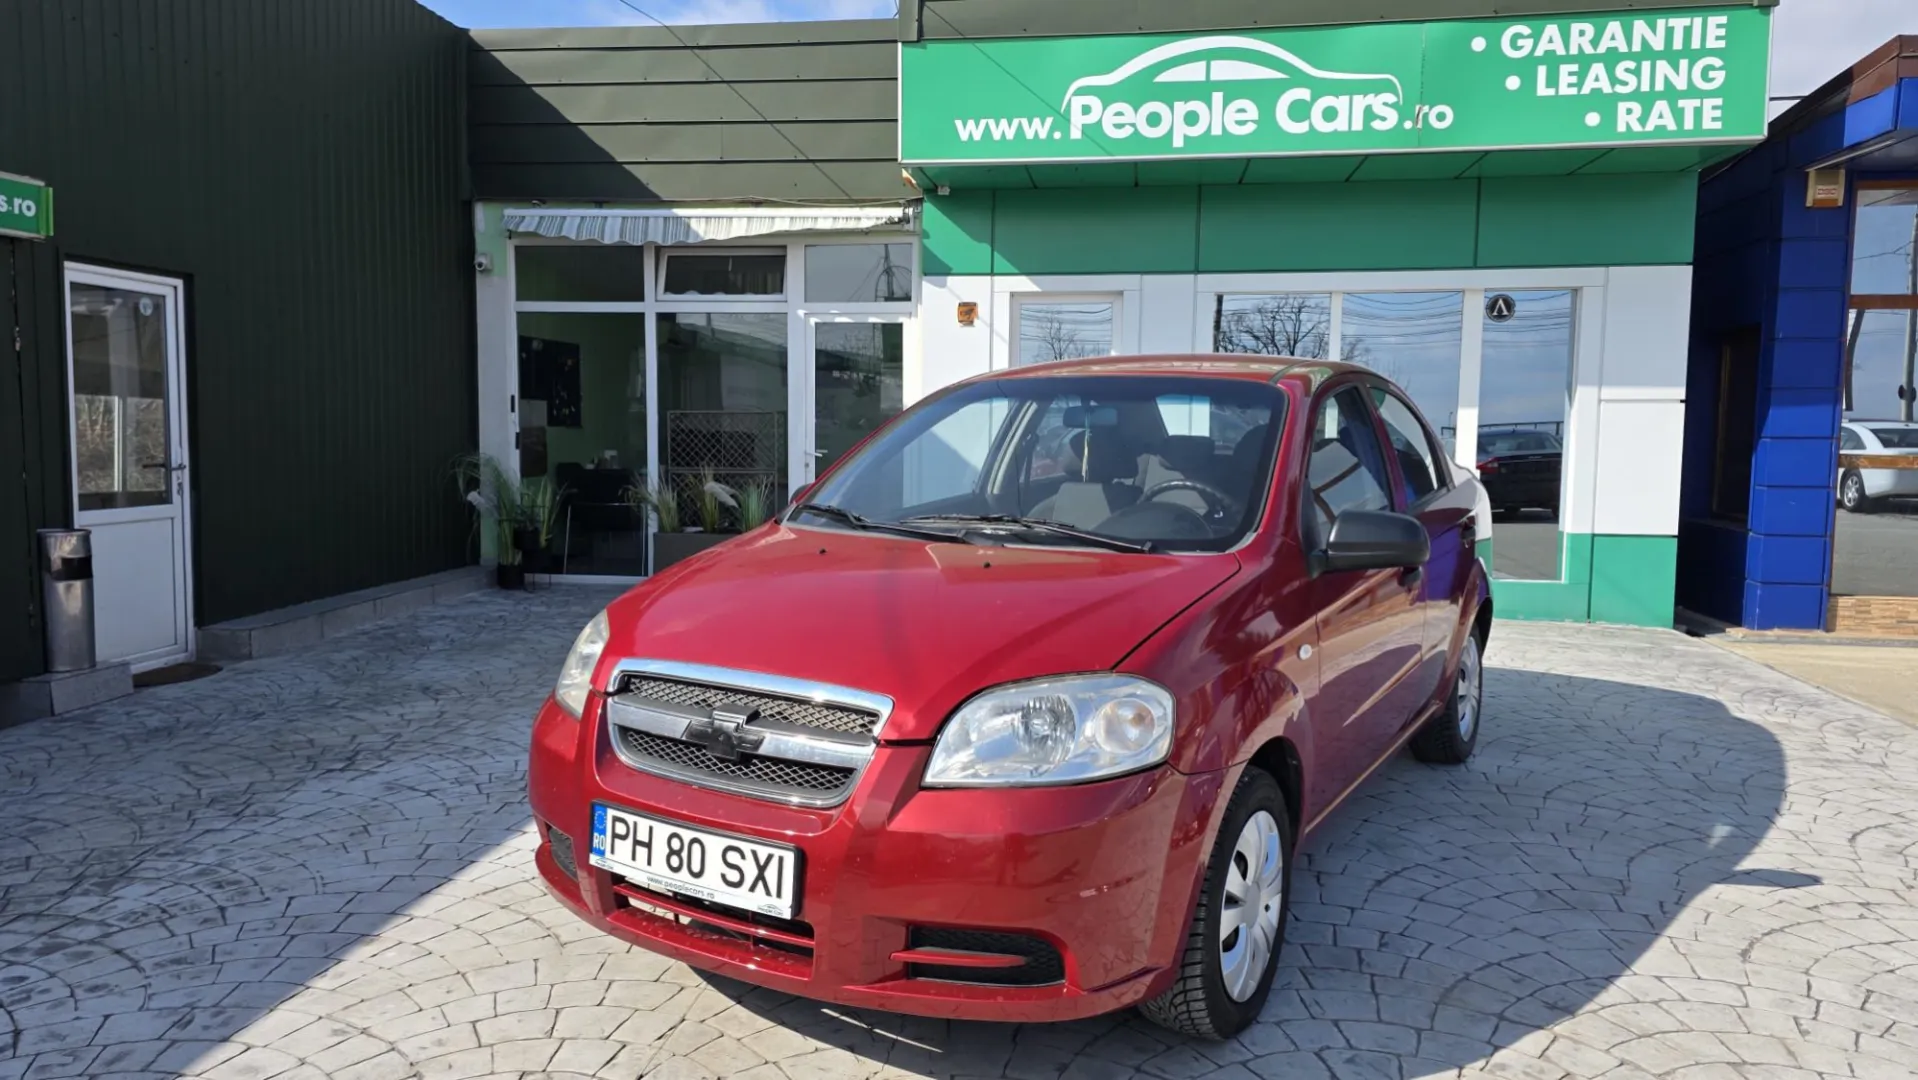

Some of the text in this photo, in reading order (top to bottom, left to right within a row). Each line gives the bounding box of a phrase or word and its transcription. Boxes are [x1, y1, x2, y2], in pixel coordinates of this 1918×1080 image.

[1501, 16, 1727, 58] GARANTIE
[1536, 57, 1726, 96] LEASING
[1617, 98, 1723, 132] RATE
[593, 832, 606, 850] RO
[611, 815, 784, 899] PH 80 SXI
